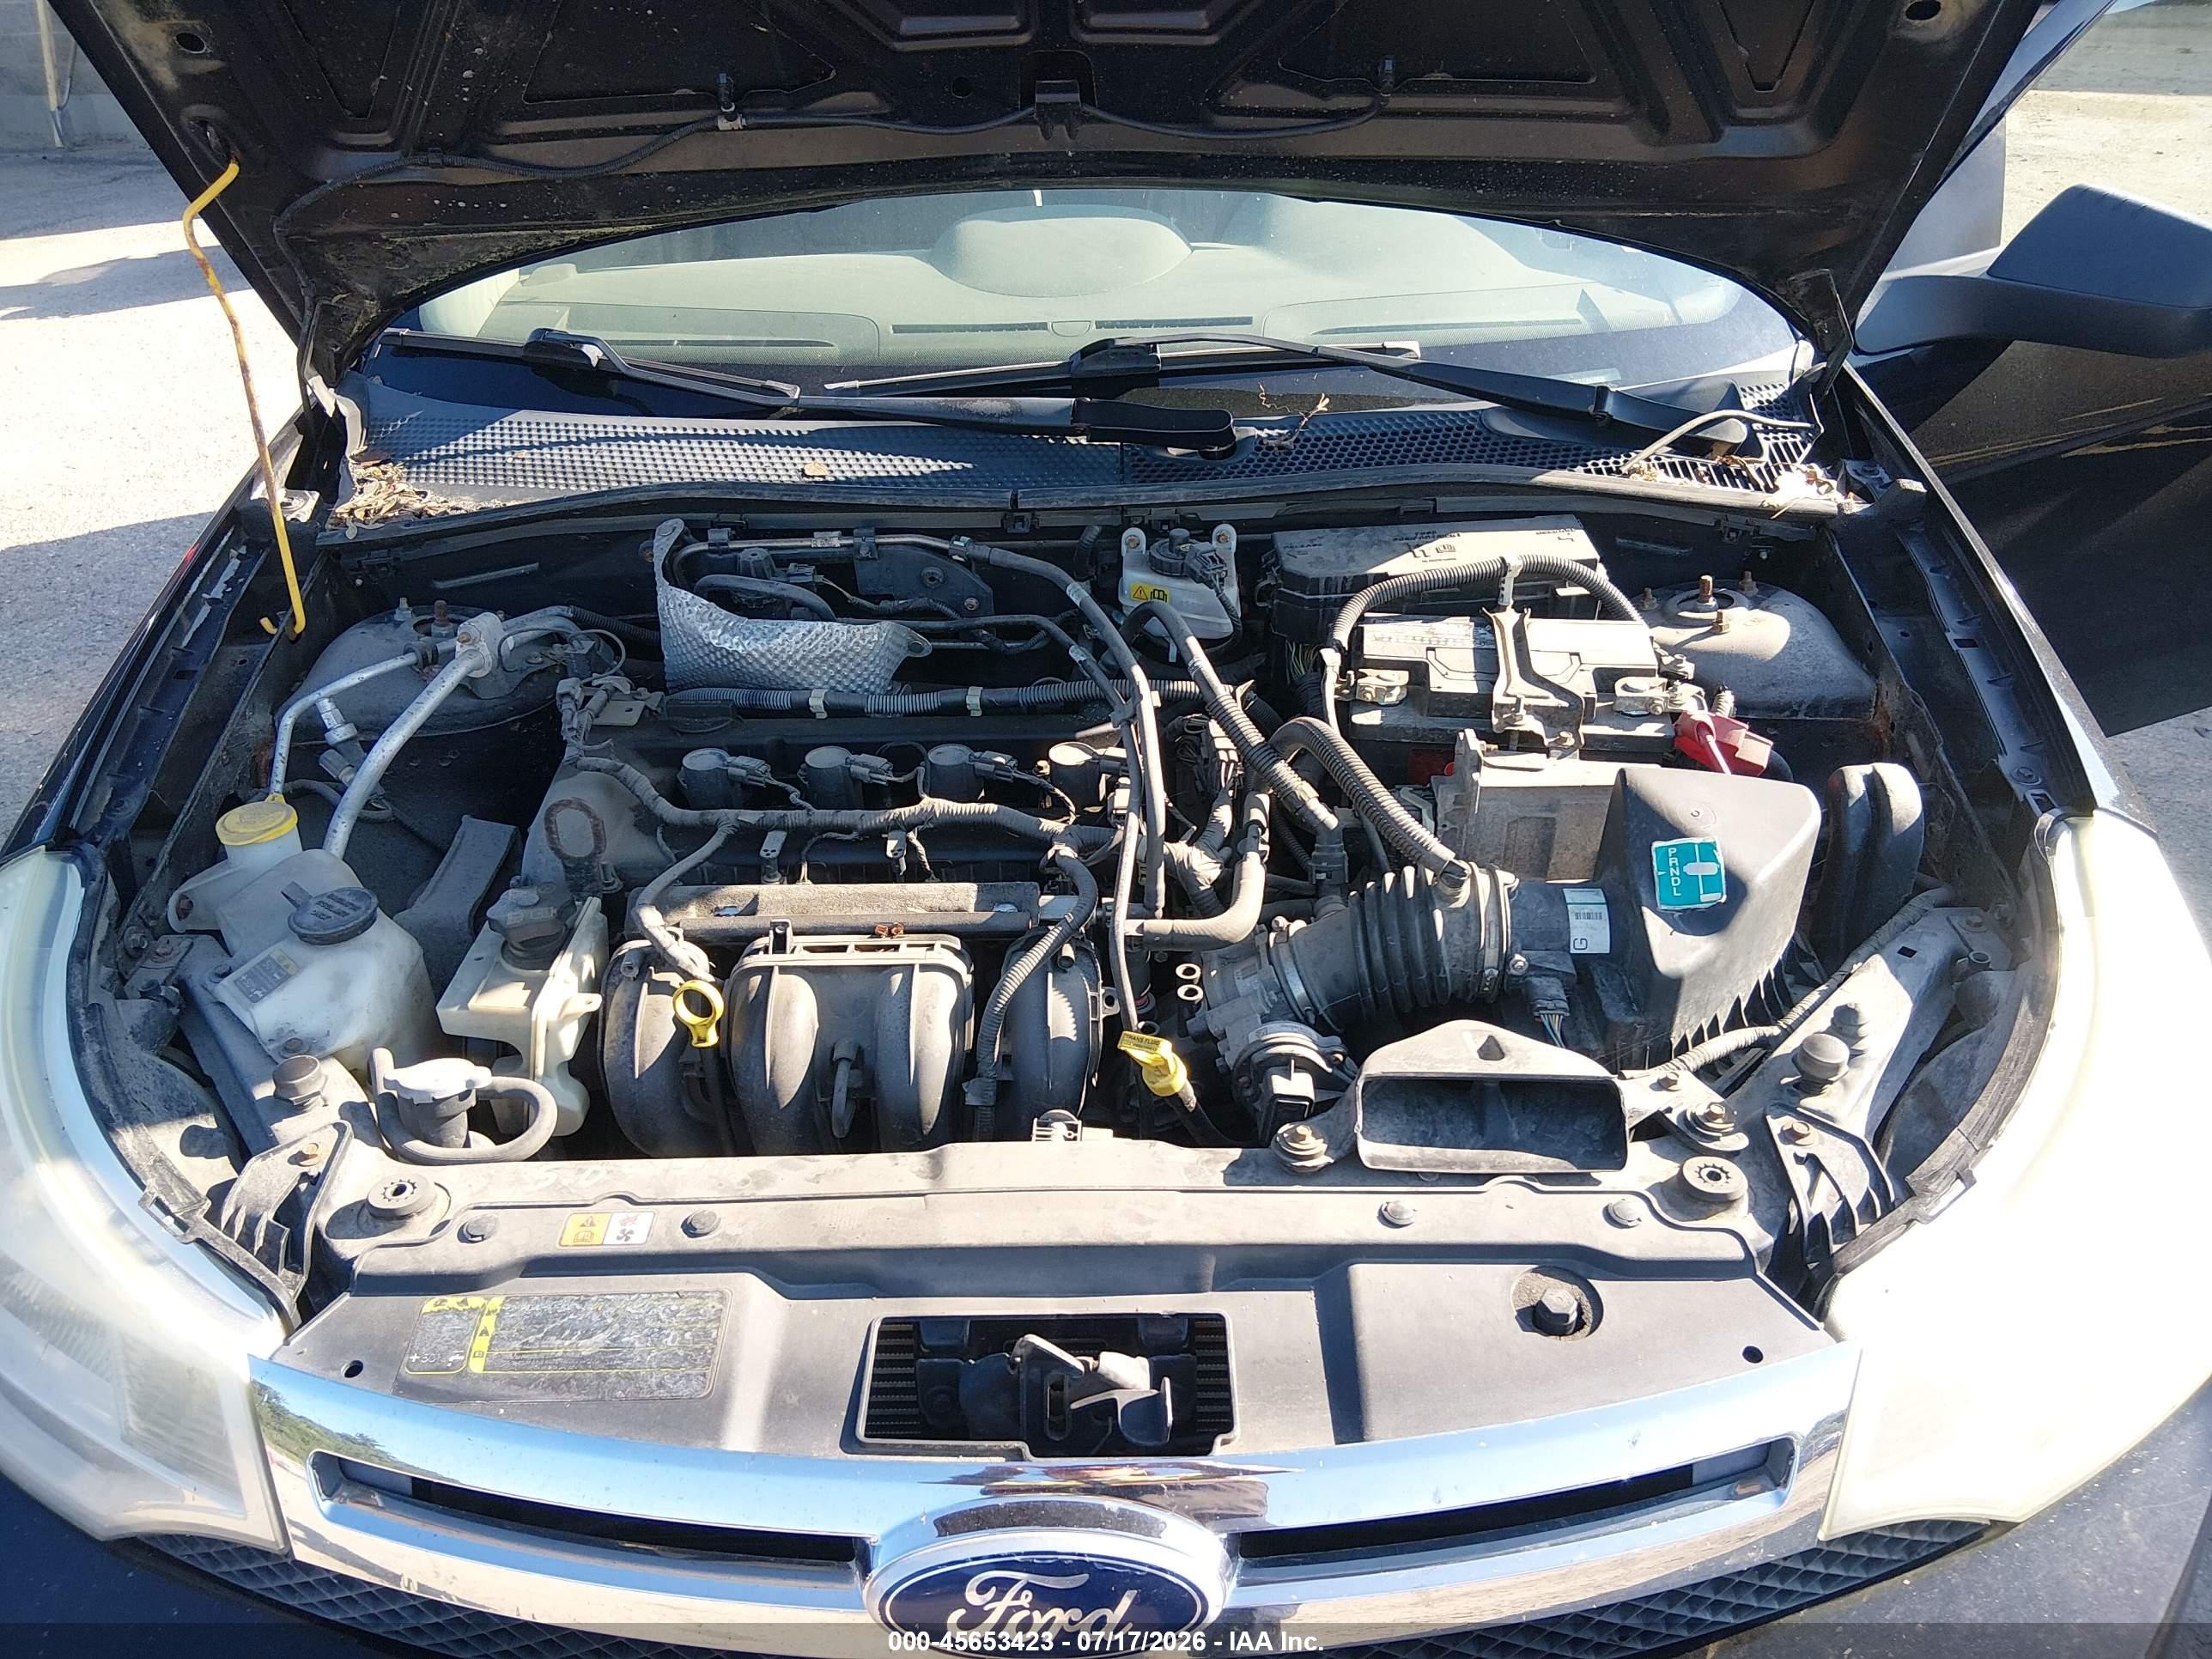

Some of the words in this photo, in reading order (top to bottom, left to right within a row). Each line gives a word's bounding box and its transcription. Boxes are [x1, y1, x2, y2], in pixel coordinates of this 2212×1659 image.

[1573, 938, 1588, 951] G
[1126, 1033, 1144, 1042] TRANS
[1145, 1037, 1160, 1046] FLUID
[946, 1570, 1138, 1643] Ford
